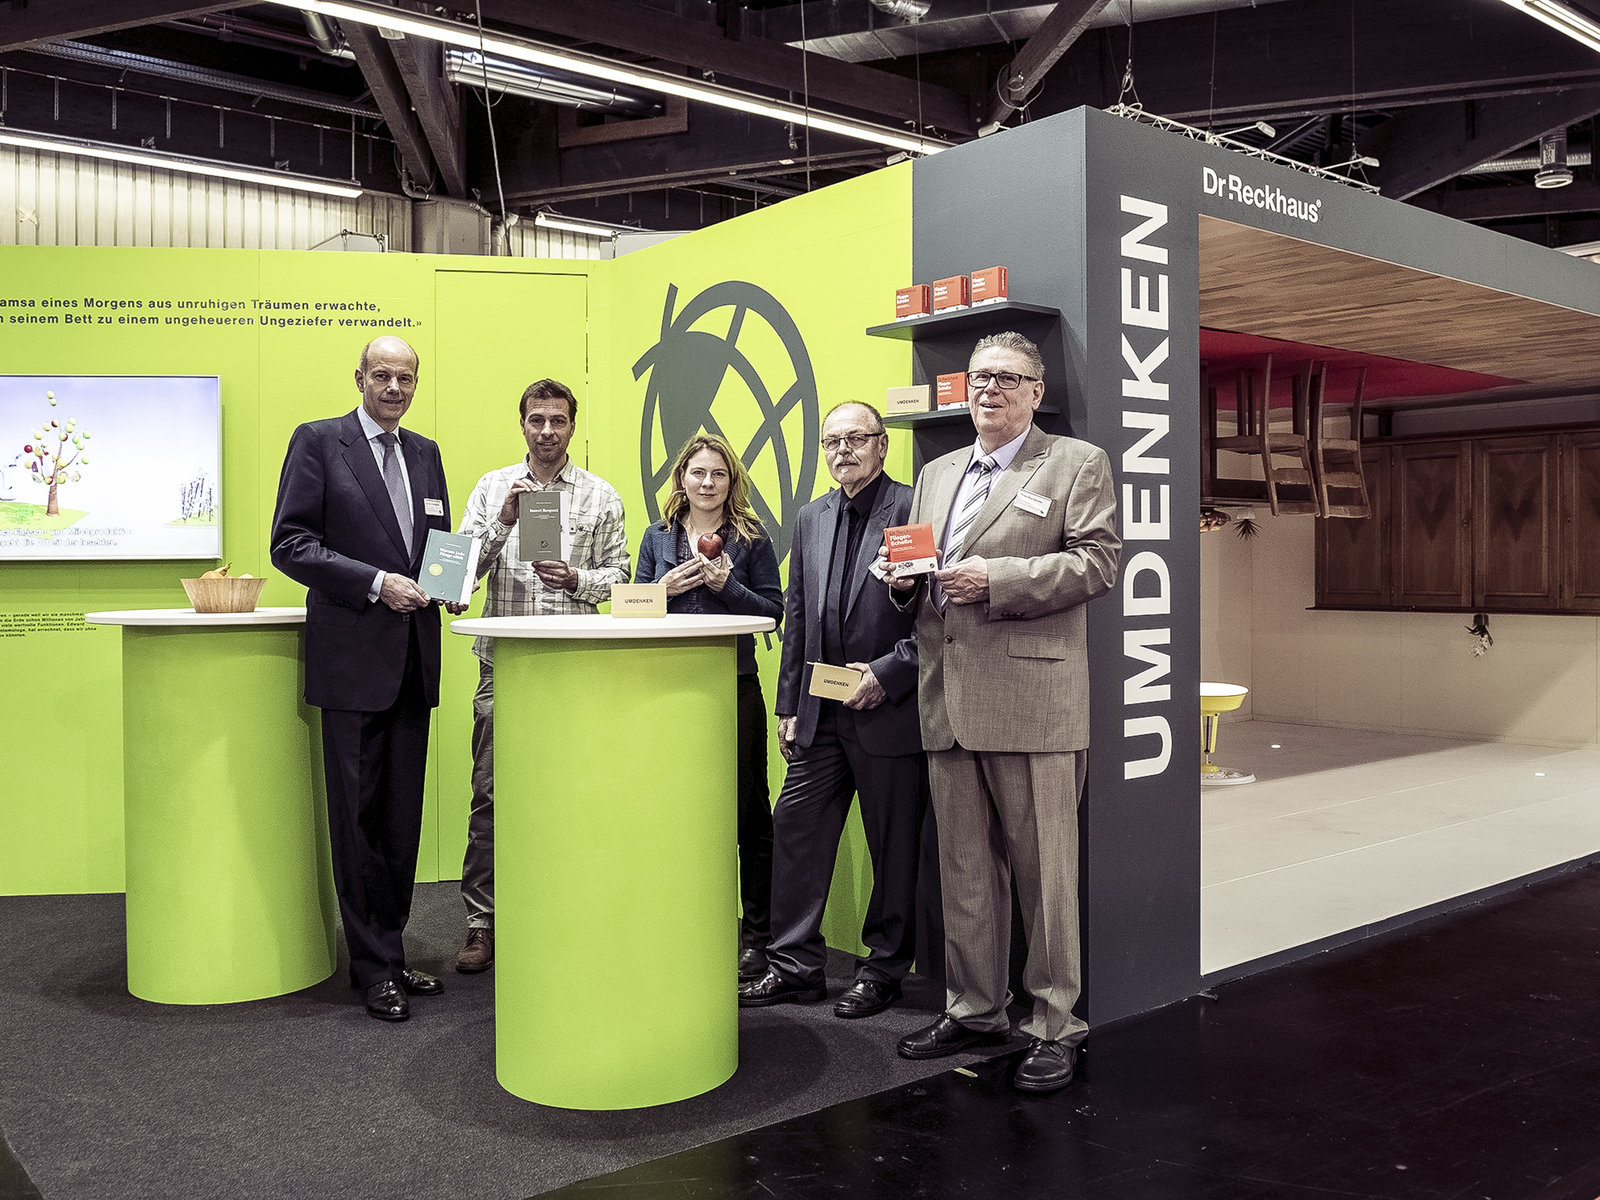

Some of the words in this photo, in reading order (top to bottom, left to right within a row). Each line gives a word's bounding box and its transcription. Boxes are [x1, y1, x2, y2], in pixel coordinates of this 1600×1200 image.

[41, 297, 78, 308] eines
[84, 298, 143, 310] Morgens
[148, 300, 172, 308] aus
[177, 299, 246, 311] unruhigen
[251, 299, 309, 310] Träumen
[315, 301, 381, 312] erwachte,
[9, 313, 59, 324] seinem
[65, 314, 93, 324] Bett
[97, 316, 113, 324] zu
[118, 314, 159, 324] einem
[165, 315, 254, 327] ungeheueren
[260, 315, 333, 328] Ungeziefer
[1120, 194, 1172, 781] UMDENKEN
[823, 678, 850, 687] UMDENKEN
